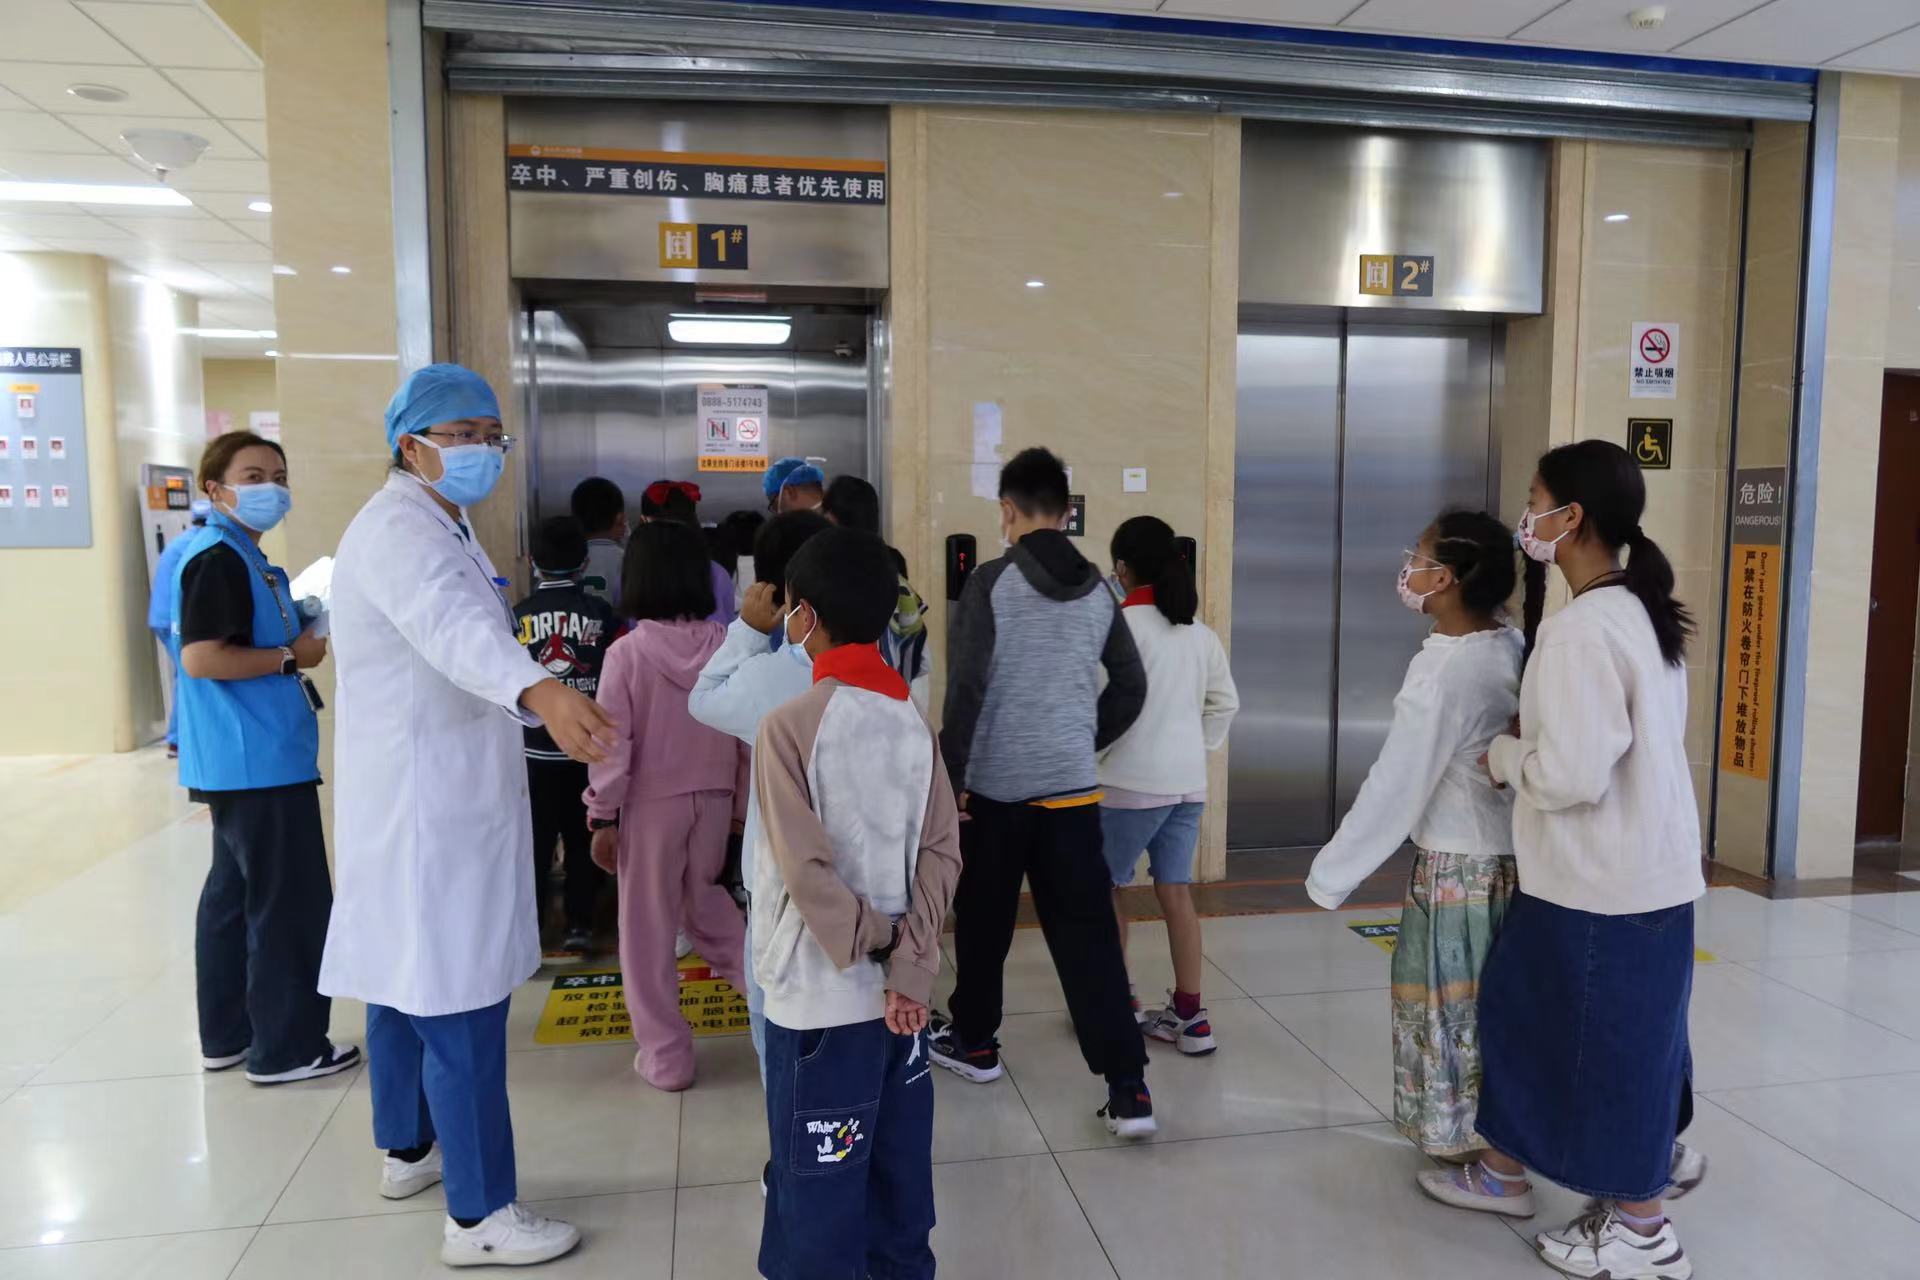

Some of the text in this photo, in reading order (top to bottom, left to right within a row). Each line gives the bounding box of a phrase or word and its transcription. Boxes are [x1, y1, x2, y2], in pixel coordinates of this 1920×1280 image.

[511, 163, 885, 200] 卒中、严重创伤、胸痛患者优先使用
[1634, 367, 1674, 378] 禁止吸烟
[1733, 550, 1757, 768] 严禁在防火卷帘门下堆放物品
[563, 973, 616, 987] 卒中
